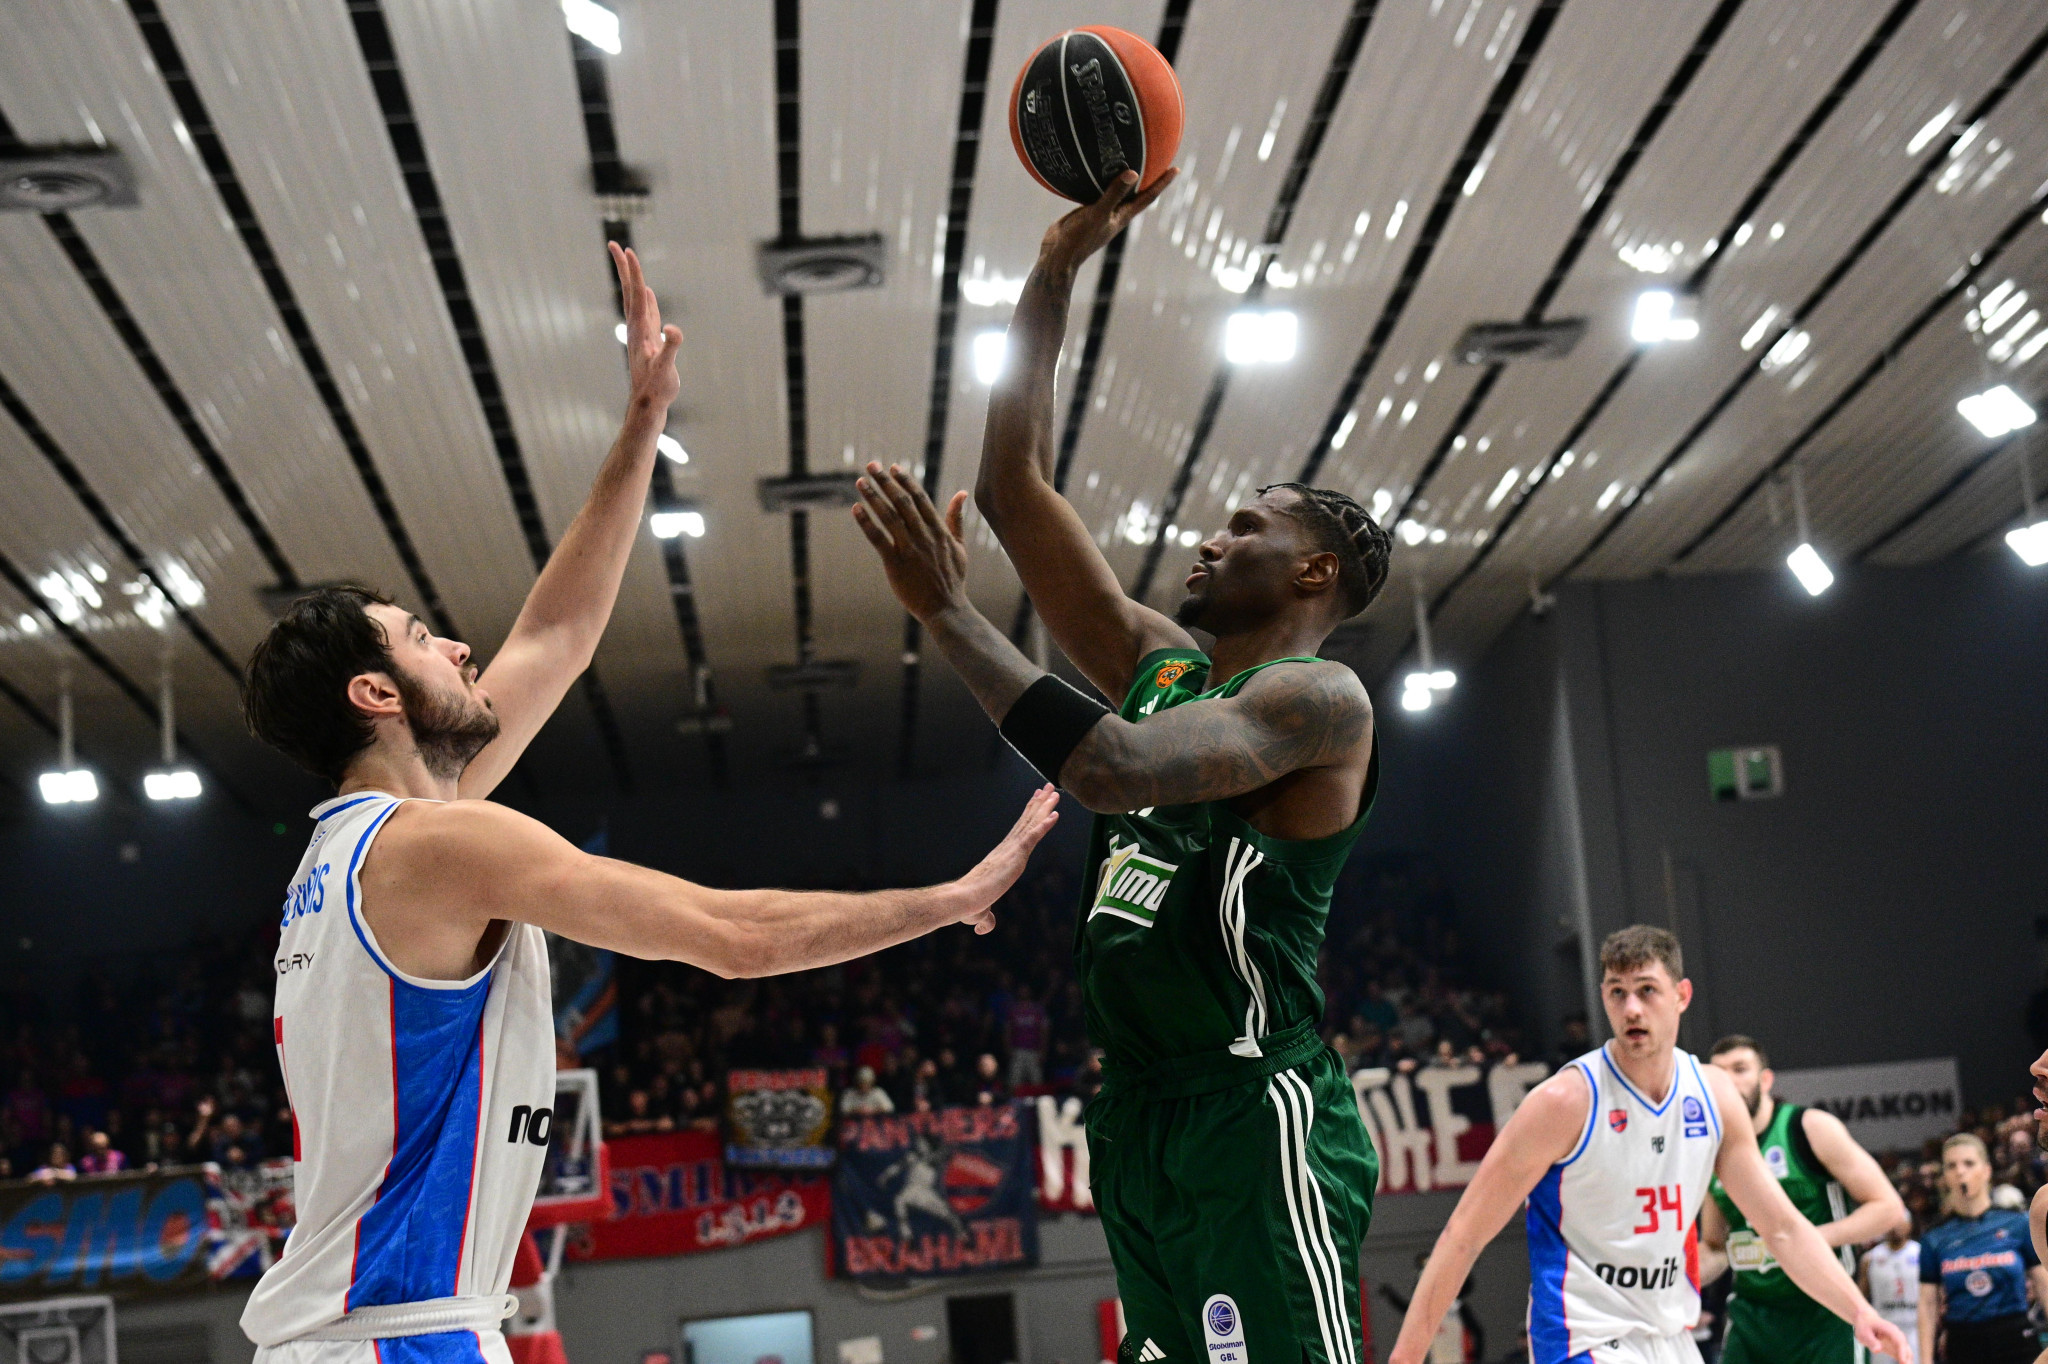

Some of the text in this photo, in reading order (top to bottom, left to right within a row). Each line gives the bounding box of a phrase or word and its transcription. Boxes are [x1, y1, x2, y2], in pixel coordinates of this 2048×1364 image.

[1634, 1184, 1683, 1234] 34
[1209, 1341, 1244, 1351] Stoiximan
[1220, 1352, 1238, 1362] GBL
